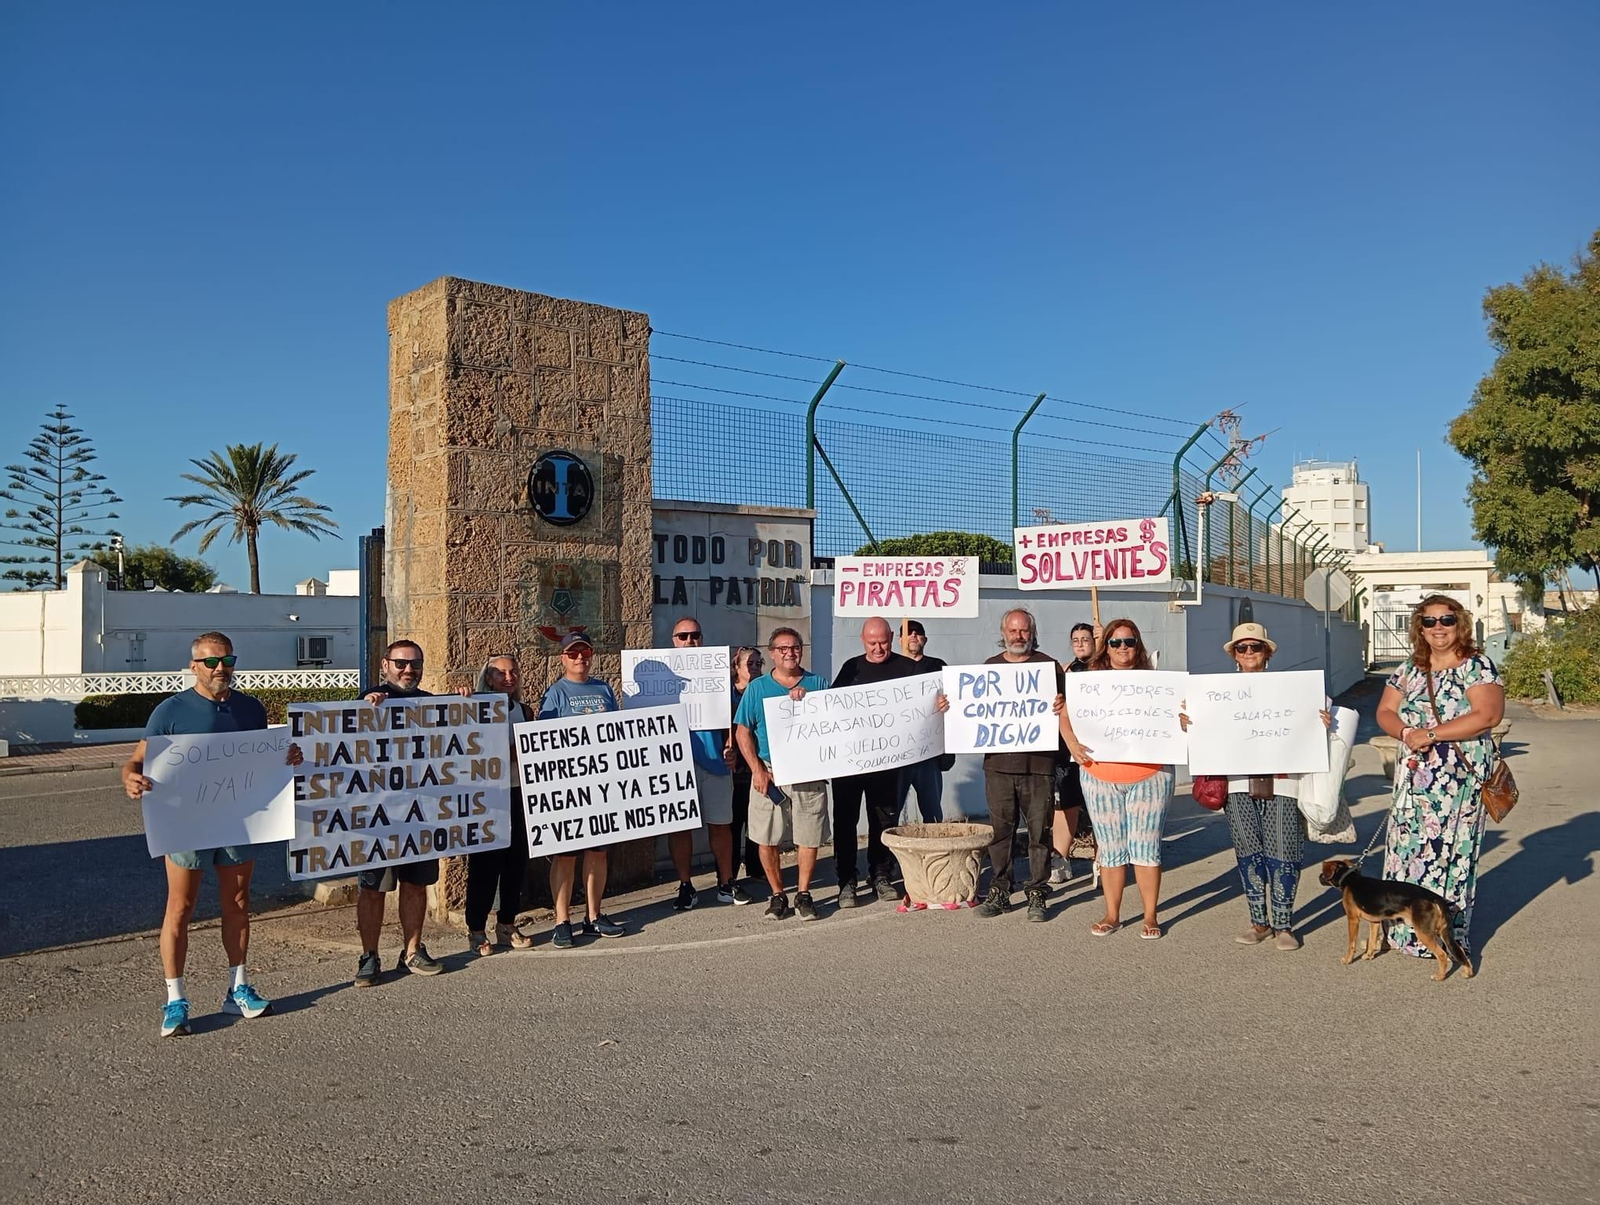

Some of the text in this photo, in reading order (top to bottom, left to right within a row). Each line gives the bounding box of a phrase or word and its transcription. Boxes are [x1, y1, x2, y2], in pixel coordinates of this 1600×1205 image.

[653, 534, 797, 568] TODO POR
[1037, 527, 1128, 548] EMPRESAS
[863, 562, 944, 577] EMPRESAS
[1020, 541, 1168, 584] SOLVENTES
[653, 575, 797, 606] LA PATRIA
[840, 578, 961, 607] PIRATAS
[959, 669, 1041, 700] POR UN
[1080, 683, 1175, 705] POR MEJORES
[1206, 686, 1252, 701] POR UN
[779, 697, 818, 719] SEIS
[824, 688, 888, 711] PADRES
[893, 684, 913, 704] DE
[963, 699, 1048, 719] CONTRATO
[1076, 707, 1175, 721] CONDICIONES
[1233, 709, 1296, 721] SALARIO
[288, 701, 507, 737] INTERVENCIONES
[519, 714, 678, 754] DEFENSA CONTRATA
[786, 713, 894, 742] TRABAJANDO
[901, 707, 926, 723] SIN
[1104, 726, 1171, 741] LABORALES
[1246, 728, 1291, 740] DIGNO
[314, 731, 481, 767] MARITIMAS
[819, 745, 837, 763] UN
[845, 734, 900, 757] SUELDO
[907, 733, 916, 744] A
[919, 728, 932, 741] SU
[973, 722, 1041, 748] DIGNO
[167, 737, 291, 766] SOLUCIONES
[523, 743, 683, 784] EMPRESAS QUE NO
[527, 770, 695, 815] PAGAN Y YA ES LA
[312, 791, 487, 837] PAGA A SUS
[551, 818, 584, 842] VEZ
[589, 812, 619, 836] QUE
[624, 806, 656, 830] NOS
[658, 799, 699, 824] PASA
[290, 820, 496, 874] TRABAJADORES
